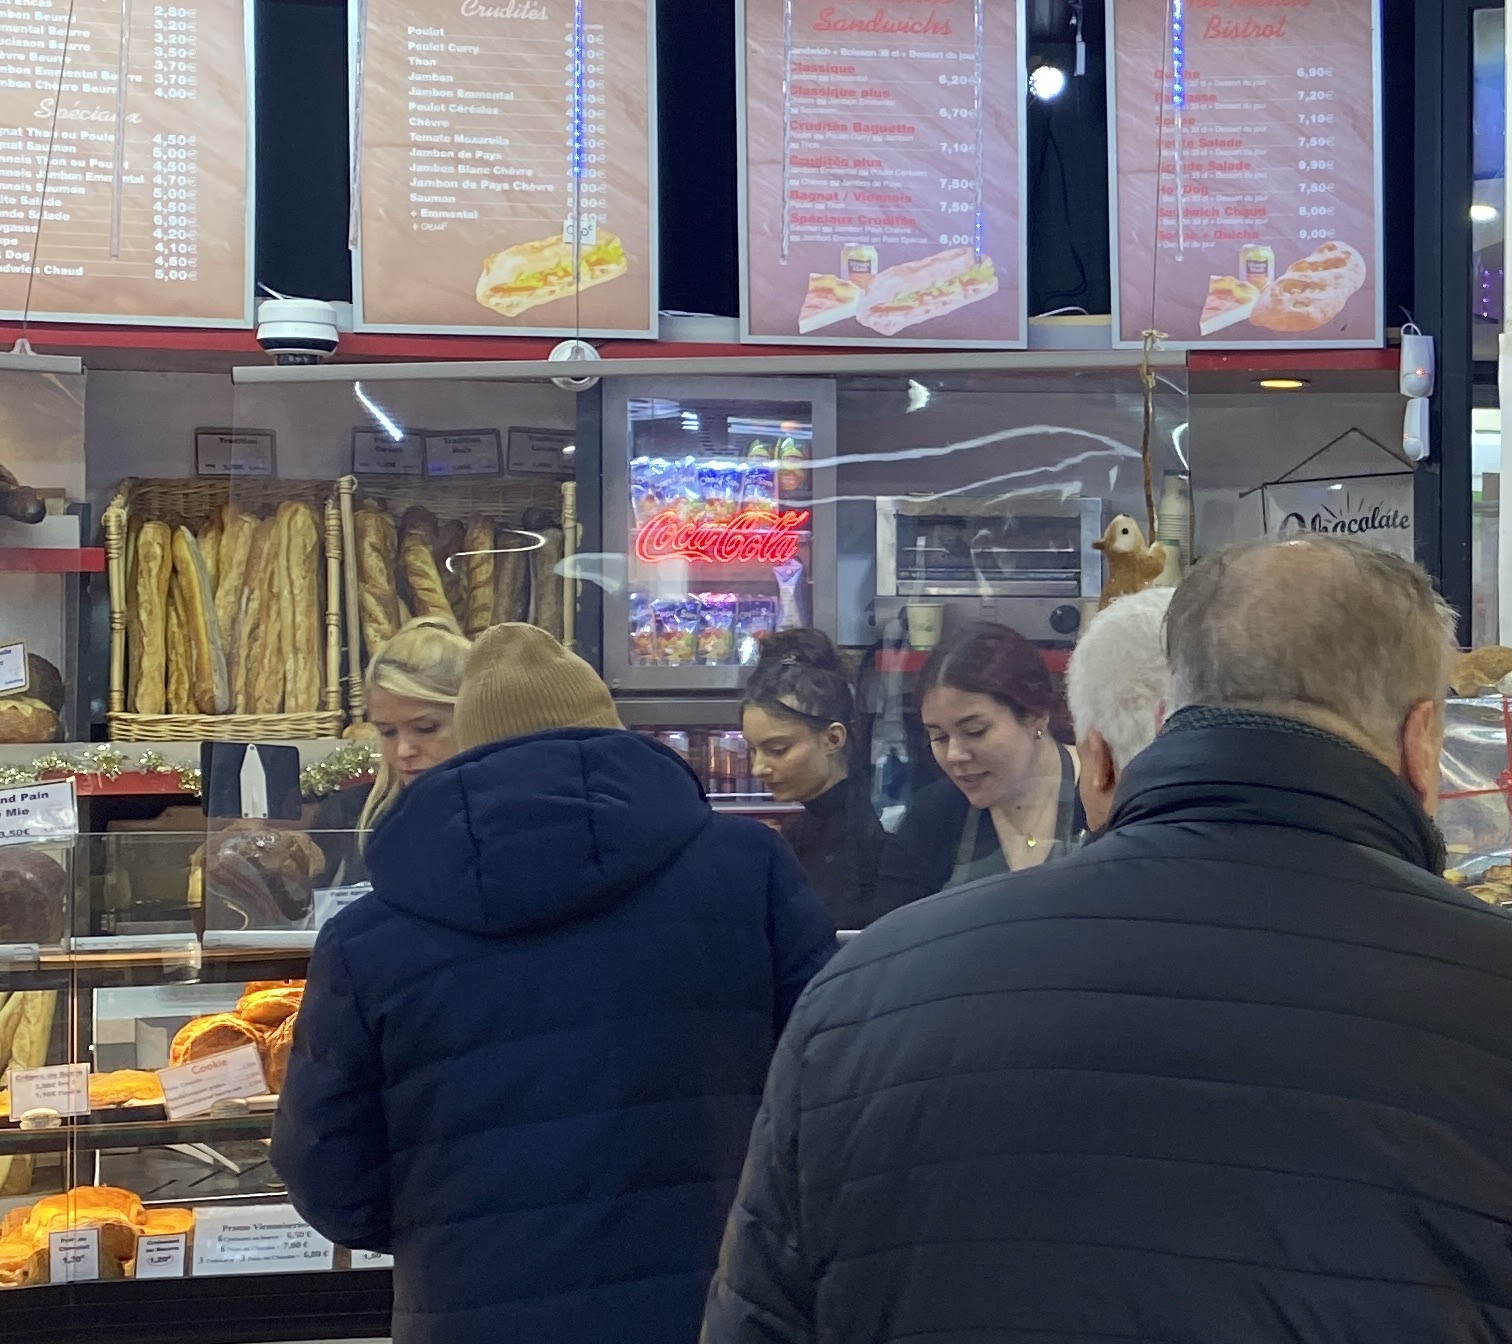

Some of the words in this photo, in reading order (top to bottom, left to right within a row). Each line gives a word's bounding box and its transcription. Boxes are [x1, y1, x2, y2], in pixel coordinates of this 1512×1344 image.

[813, 8, 953, 34] Sandwichs
[407, 26, 445, 37] Poulet
[1203, 14, 1288, 40] Bistrot
[407, 41, 445, 52] Poulet
[408, 87, 453, 98] Jambon
[408, 102, 445, 113] Poulet
[409, 148, 454, 158] Jambon
[458, 150, 472, 159] de
[409, 163, 455, 173] Jambon
[409, 177, 458, 189] Jambon
[462, 180, 477, 190] de
[409, 192, 456, 204] Saumon
[20, 791, 50, 801] Pain
[6, 808, 30, 818] Mie
[191, 1058, 229, 1076] Cookie
